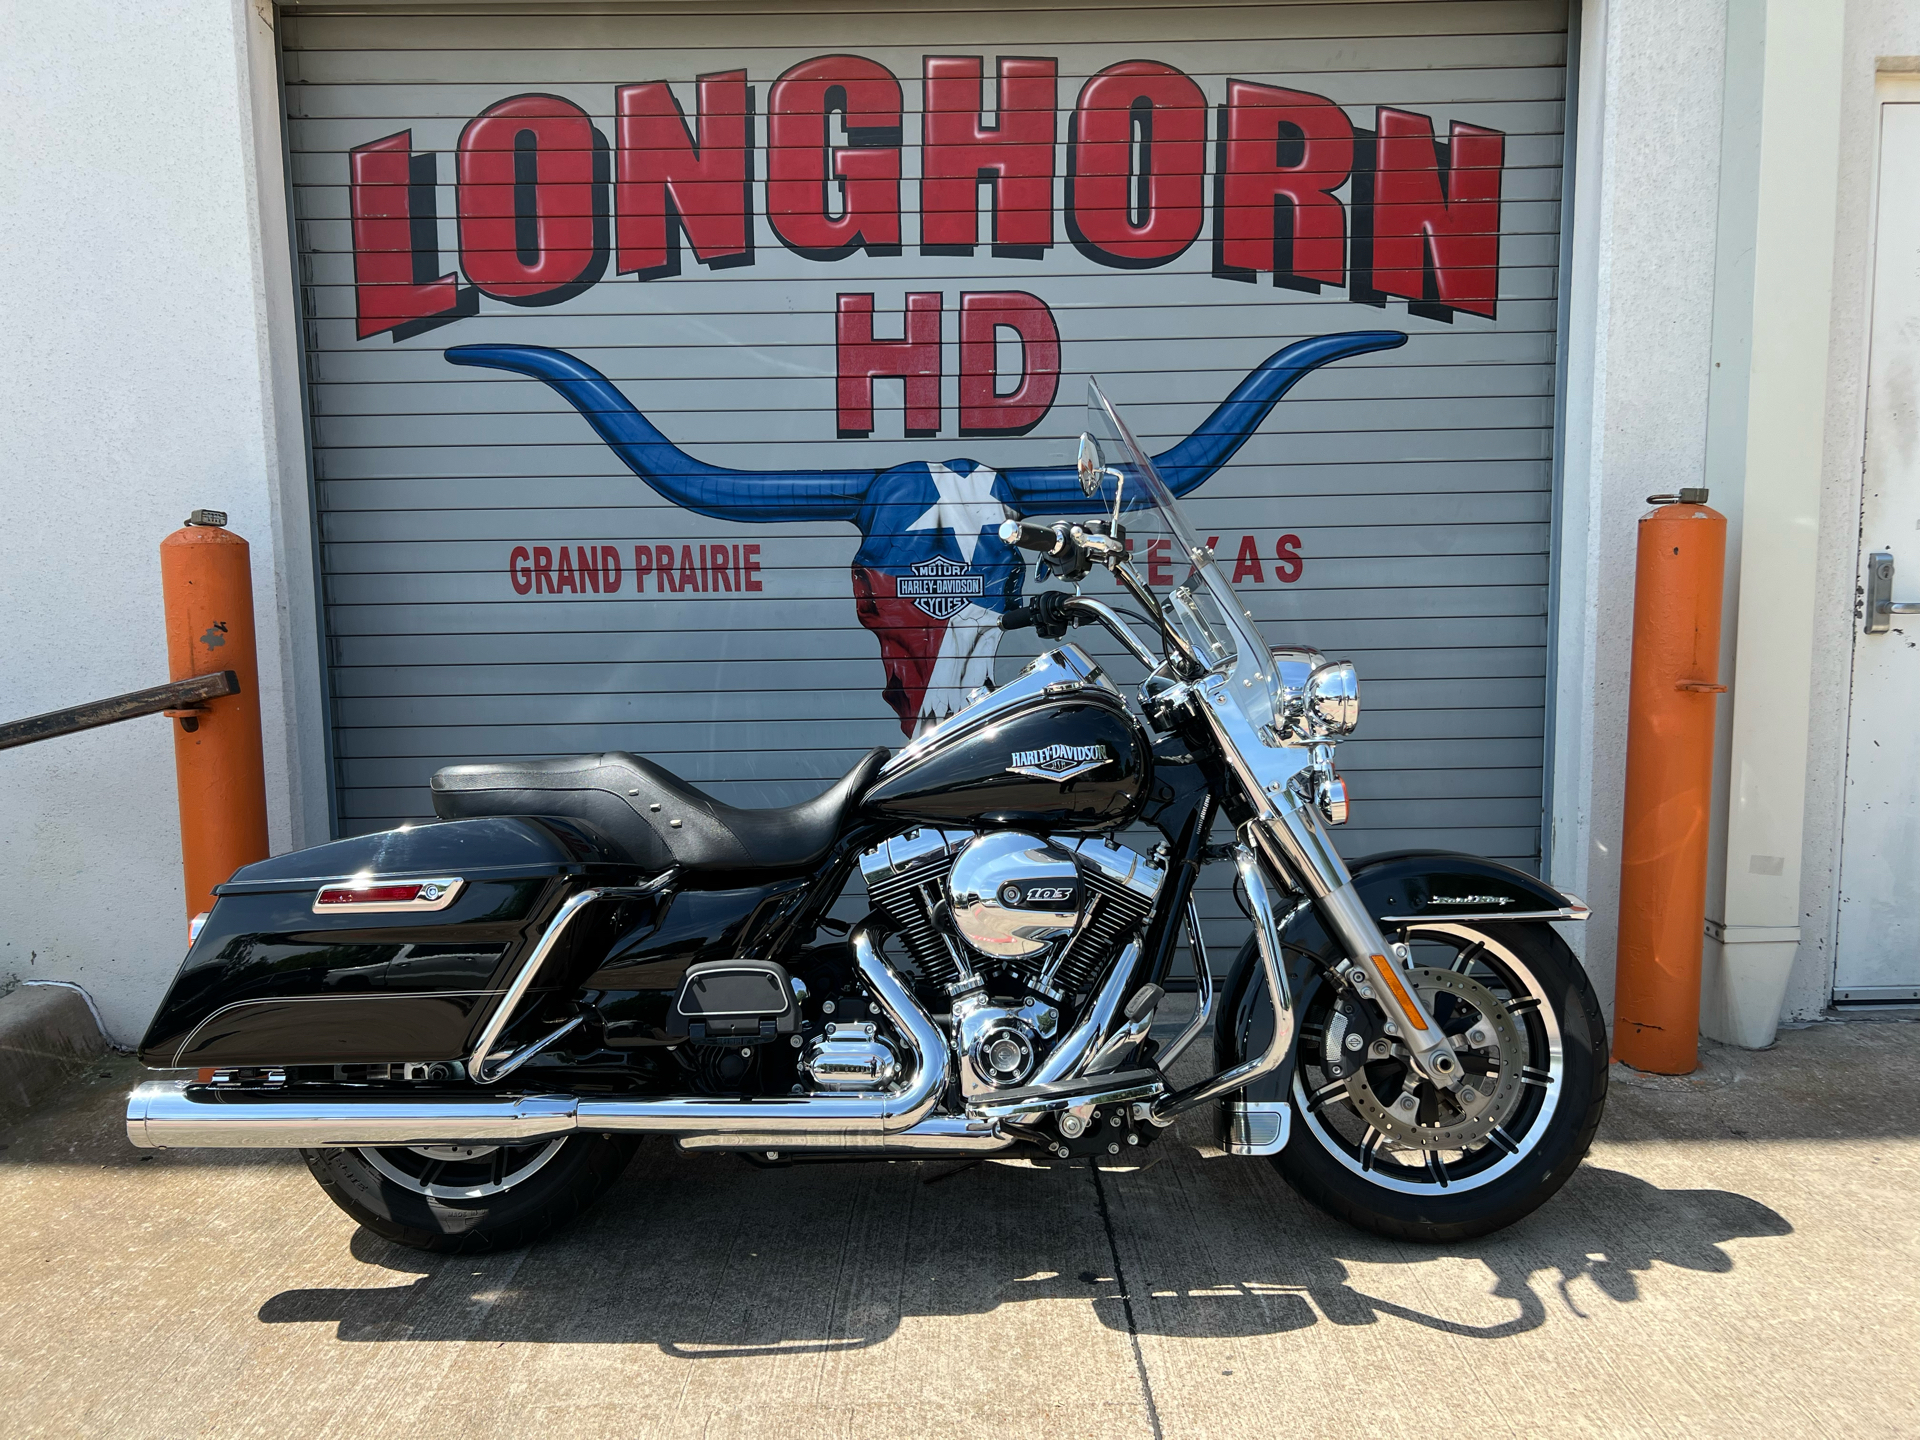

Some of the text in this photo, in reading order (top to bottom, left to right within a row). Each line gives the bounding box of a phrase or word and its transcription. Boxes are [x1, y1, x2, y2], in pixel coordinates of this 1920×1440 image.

[350, 54, 1505, 342] LONGHORN
[836, 290, 1061, 438] HD
[509, 544, 763, 595] GRAND PRAIRIE
[919, 560, 961, 576] MOTOR
[901, 579, 980, 595] HARLEY-DAVIDSON
[920, 597, 962, 617] CYCLES
[1026, 887, 1074, 901] 103
